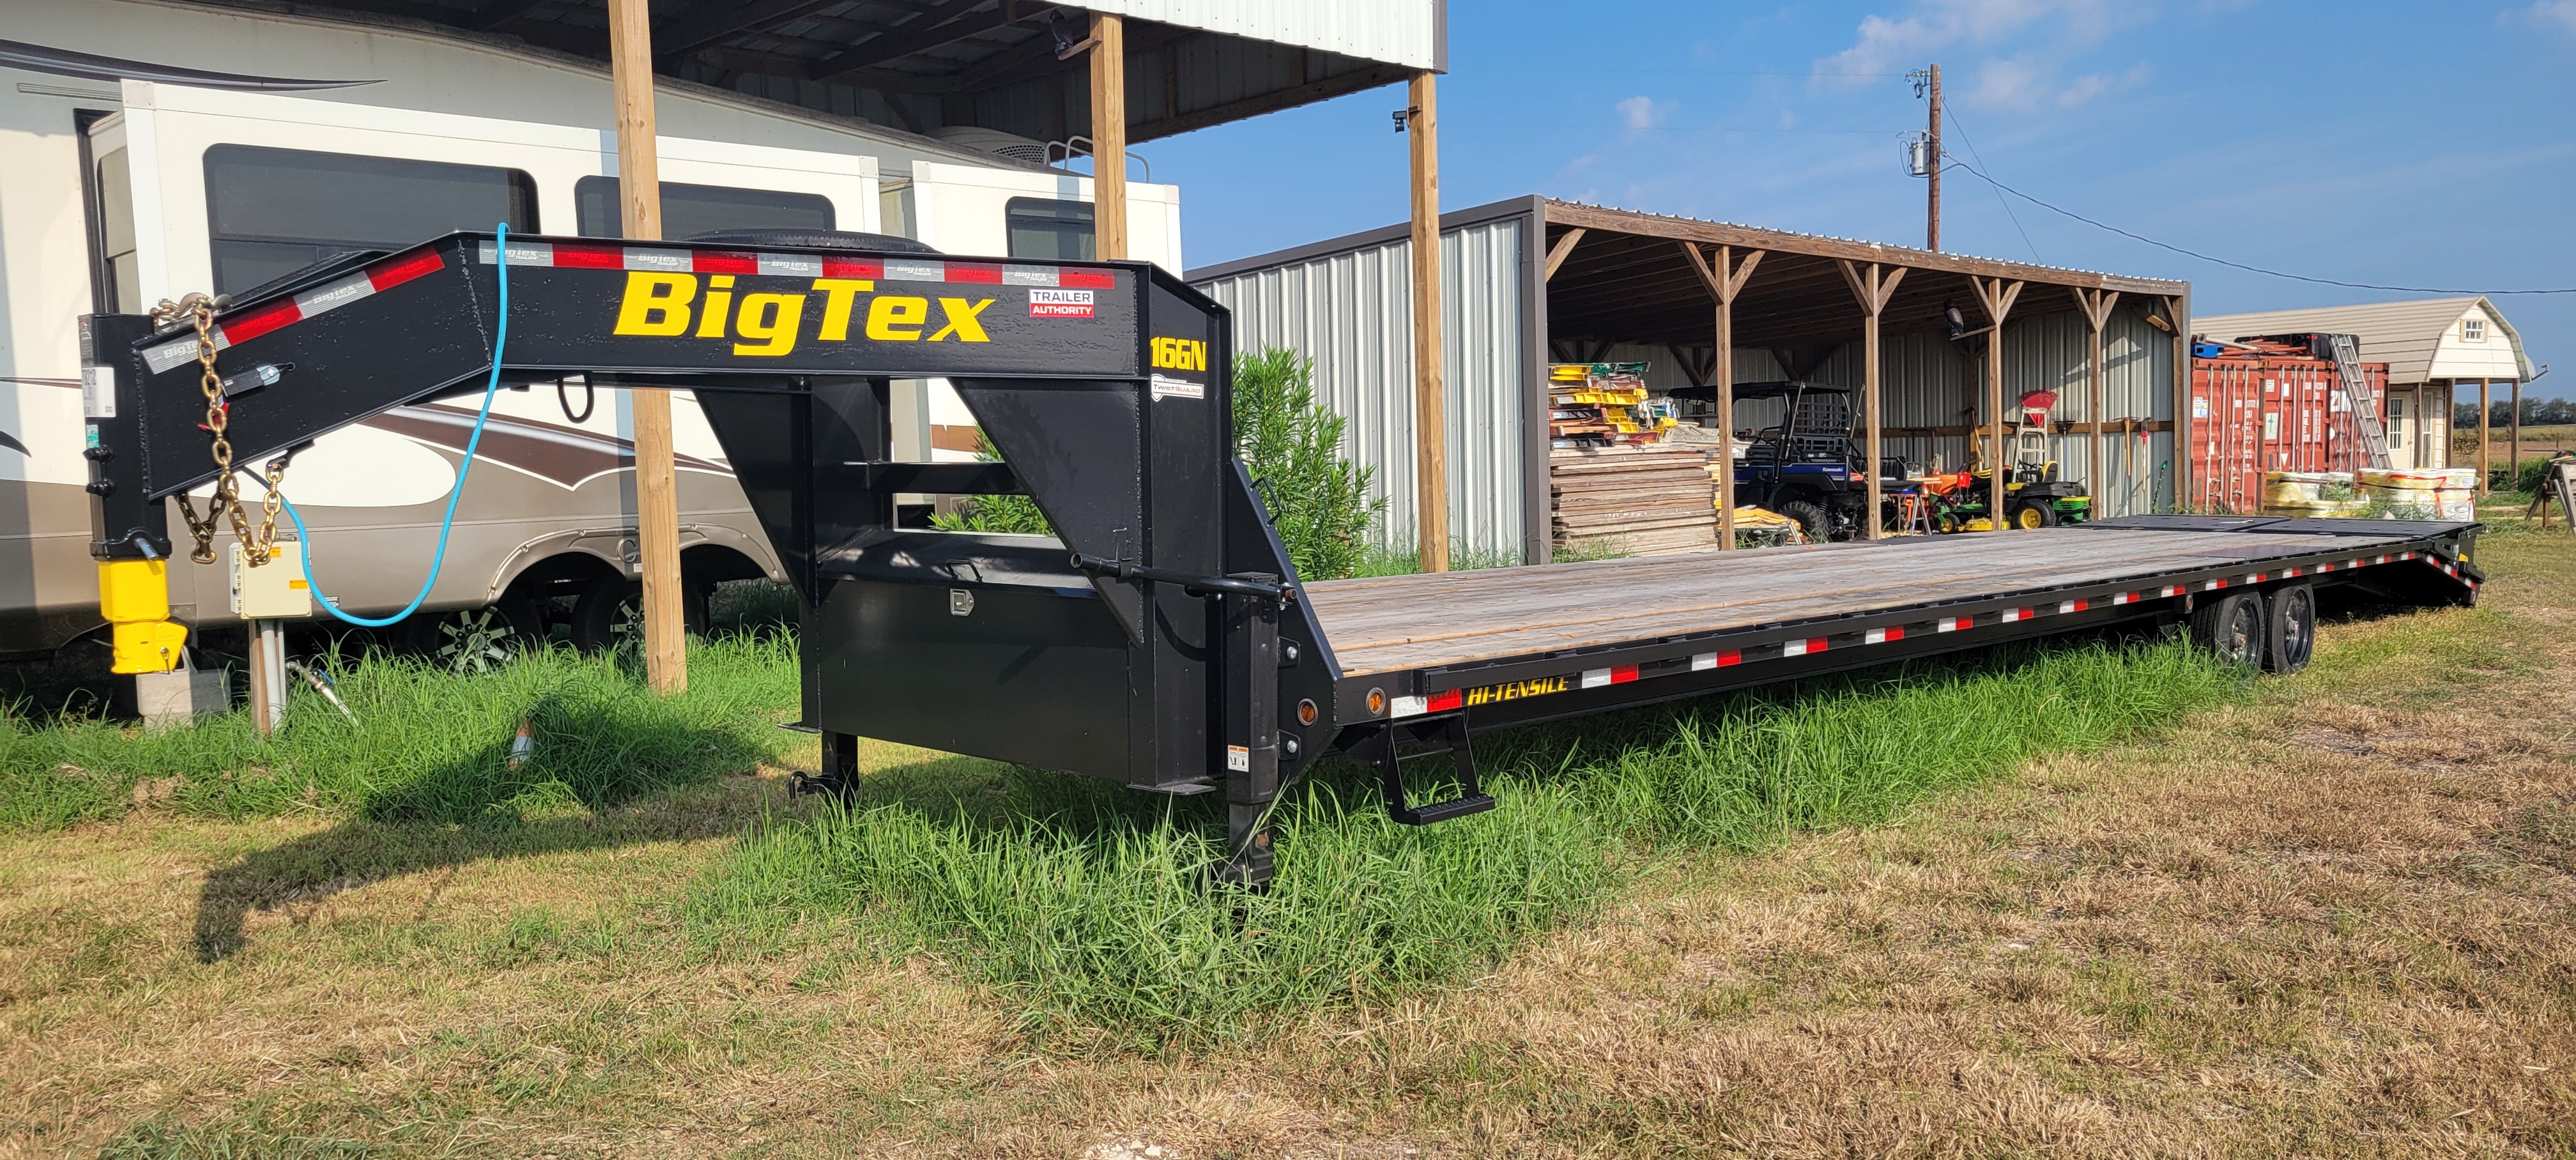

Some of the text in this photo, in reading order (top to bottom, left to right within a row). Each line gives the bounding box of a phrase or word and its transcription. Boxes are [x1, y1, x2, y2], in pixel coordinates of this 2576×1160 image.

[772, 259, 808, 269] BigTex
[897, 265, 931, 274] BigTex
[1032, 291, 1091, 303] TRAILER
[613, 271, 996, 356] BigTex
[1032, 305, 1092, 315] AUTHORITY
[164, 340, 200, 359] BigTe
[1150, 337, 1206, 371] 16GN
[1468, 676, 1569, 706] HI-TENSILE
